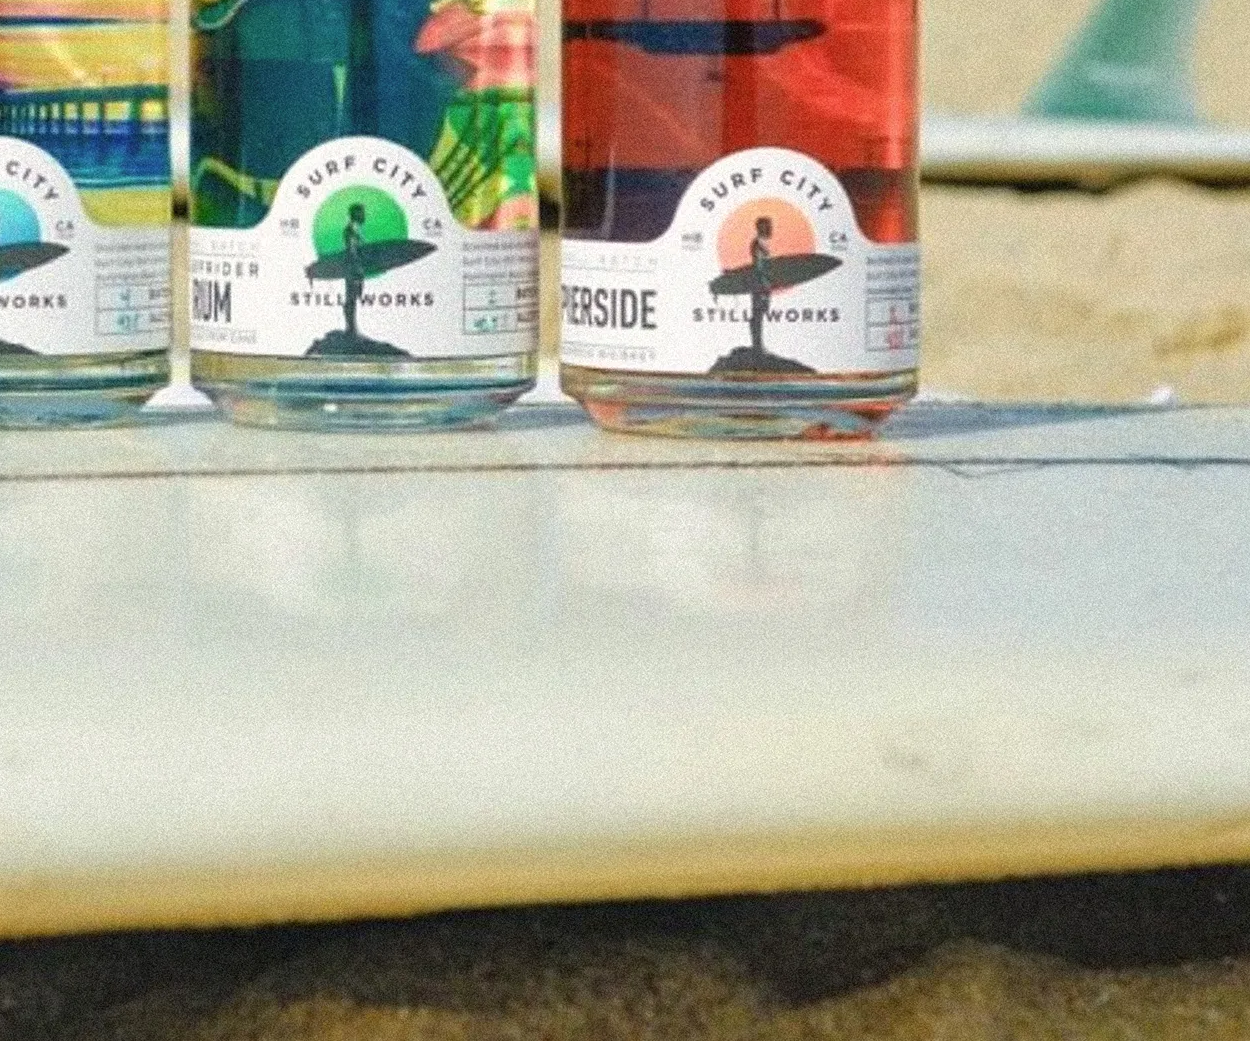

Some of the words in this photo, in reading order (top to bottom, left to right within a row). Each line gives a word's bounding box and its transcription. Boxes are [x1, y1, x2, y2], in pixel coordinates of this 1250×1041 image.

[6, 160, 60, 201] CITY
[297, 156, 357, 198] SURF
[373, 158, 429, 200] CITY
[700, 168, 764, 212] SURF
[779, 170, 835, 212] CITY
[56, 220, 74, 232] CA
[423, 218, 443, 230] CA
[828, 231, 848, 243] CA
[290, 293, 346, 307] STILL
[359, 292, 434, 307] WORKS
[693, 308, 752, 323] STILL
[767, 308, 841, 323] WORKS
